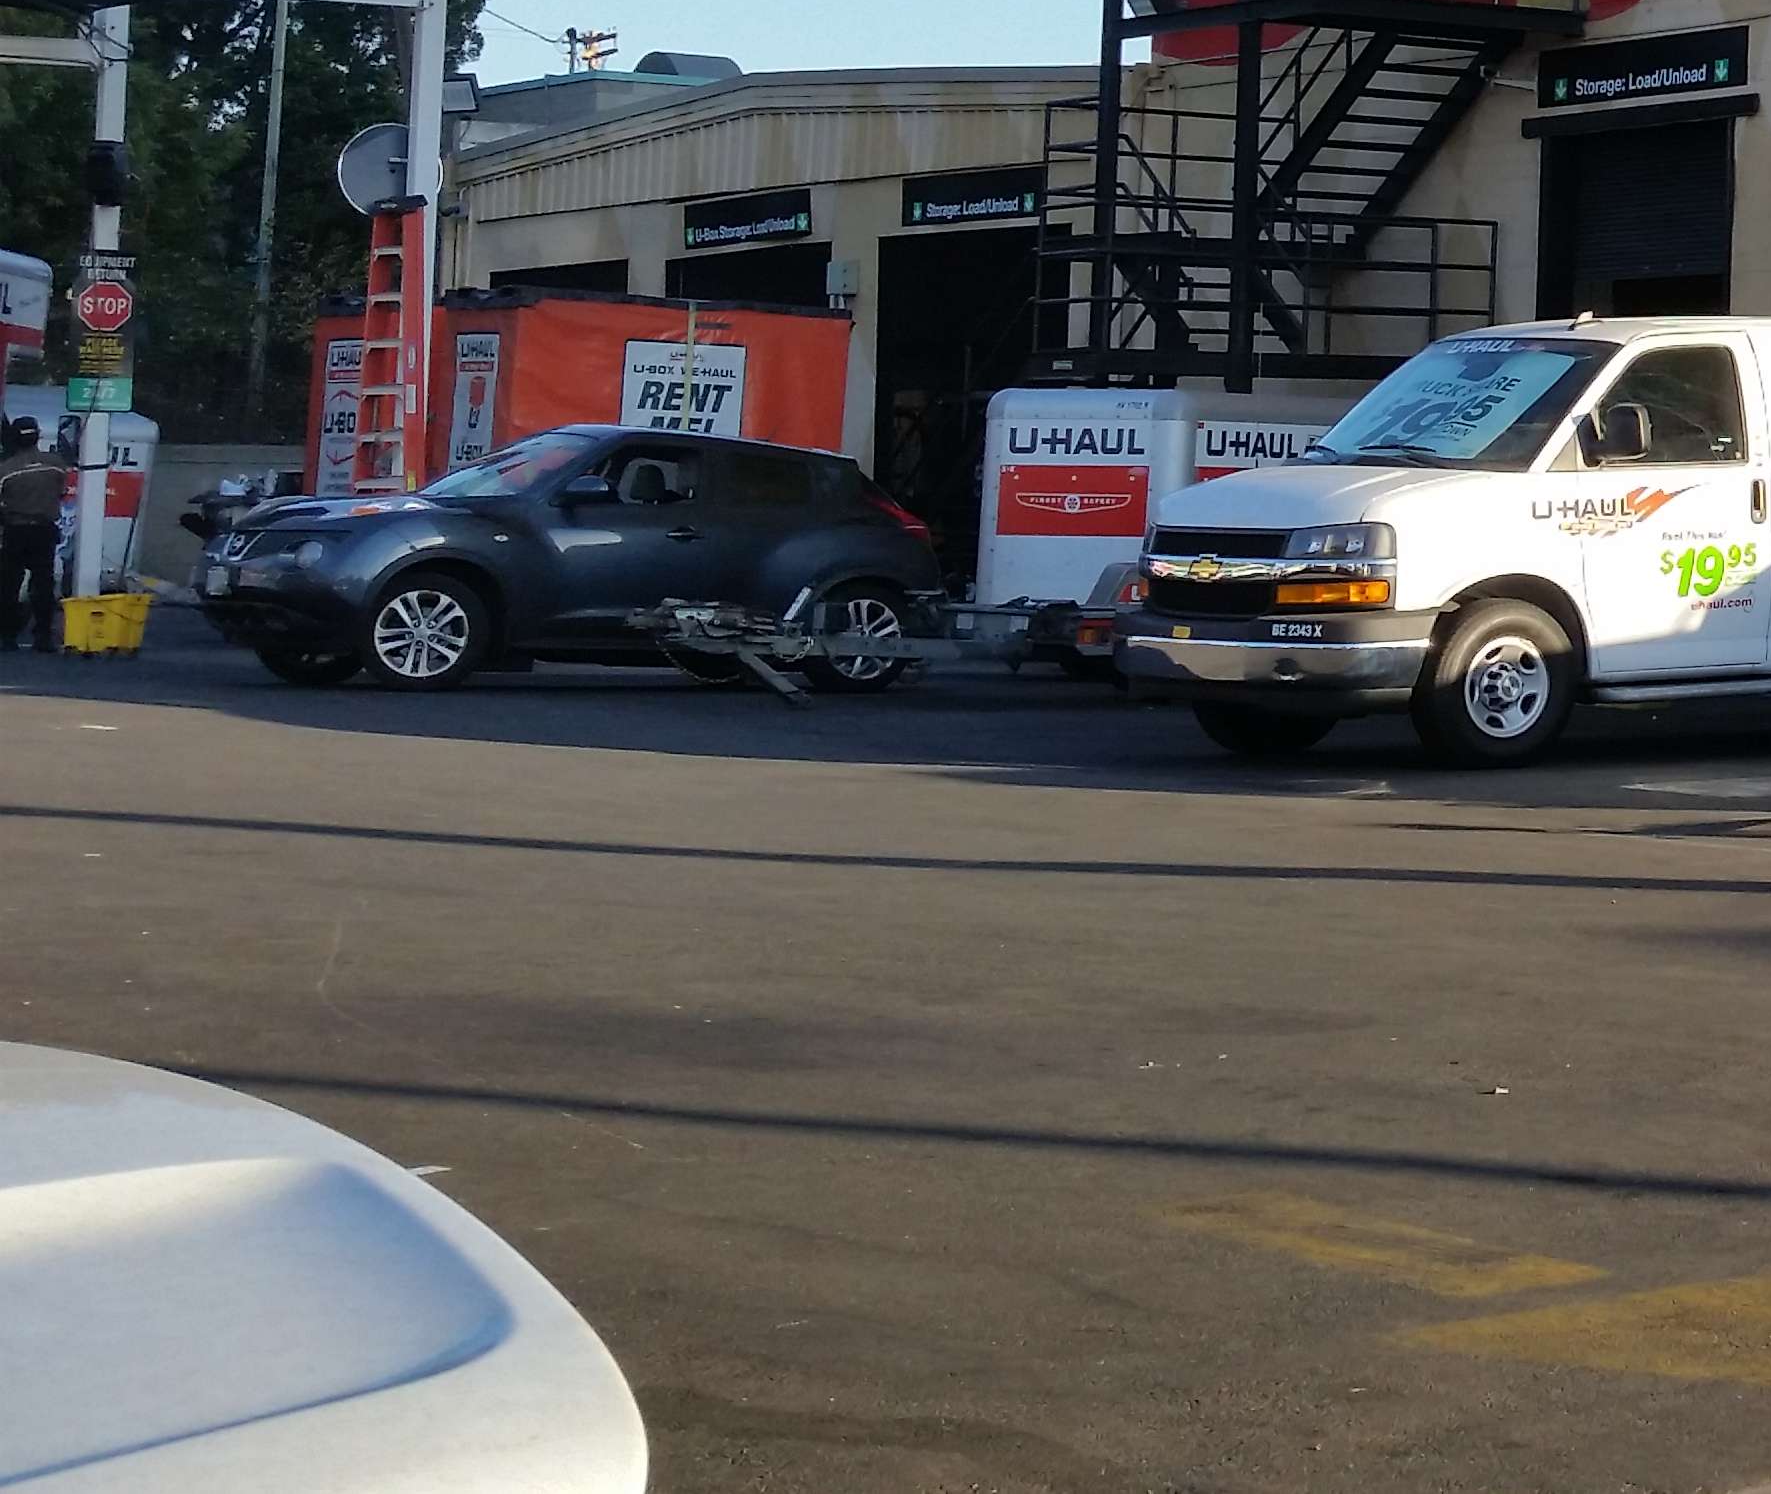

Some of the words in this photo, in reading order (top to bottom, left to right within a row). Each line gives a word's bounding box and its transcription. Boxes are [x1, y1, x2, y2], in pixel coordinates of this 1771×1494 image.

[1575, 77, 1626, 97] Storage:
[1629, 64, 1707, 91] Load/Unload
[83, 297, 128, 315] STOP
[331, 347, 362, 367] U-HAU
[1448, 340, 1517, 354] U-HAUL
[633, 364, 674, 375] U-BOX
[637, 380, 733, 413] RENT
[324, 411, 357, 434] U-BO
[1009, 427, 1145, 455] U-HAUL
[1206, 430, 1299, 459] U-HAUL
[1532, 498, 1632, 520] U-HAUL
[1313, 625, 1323, 638] X
